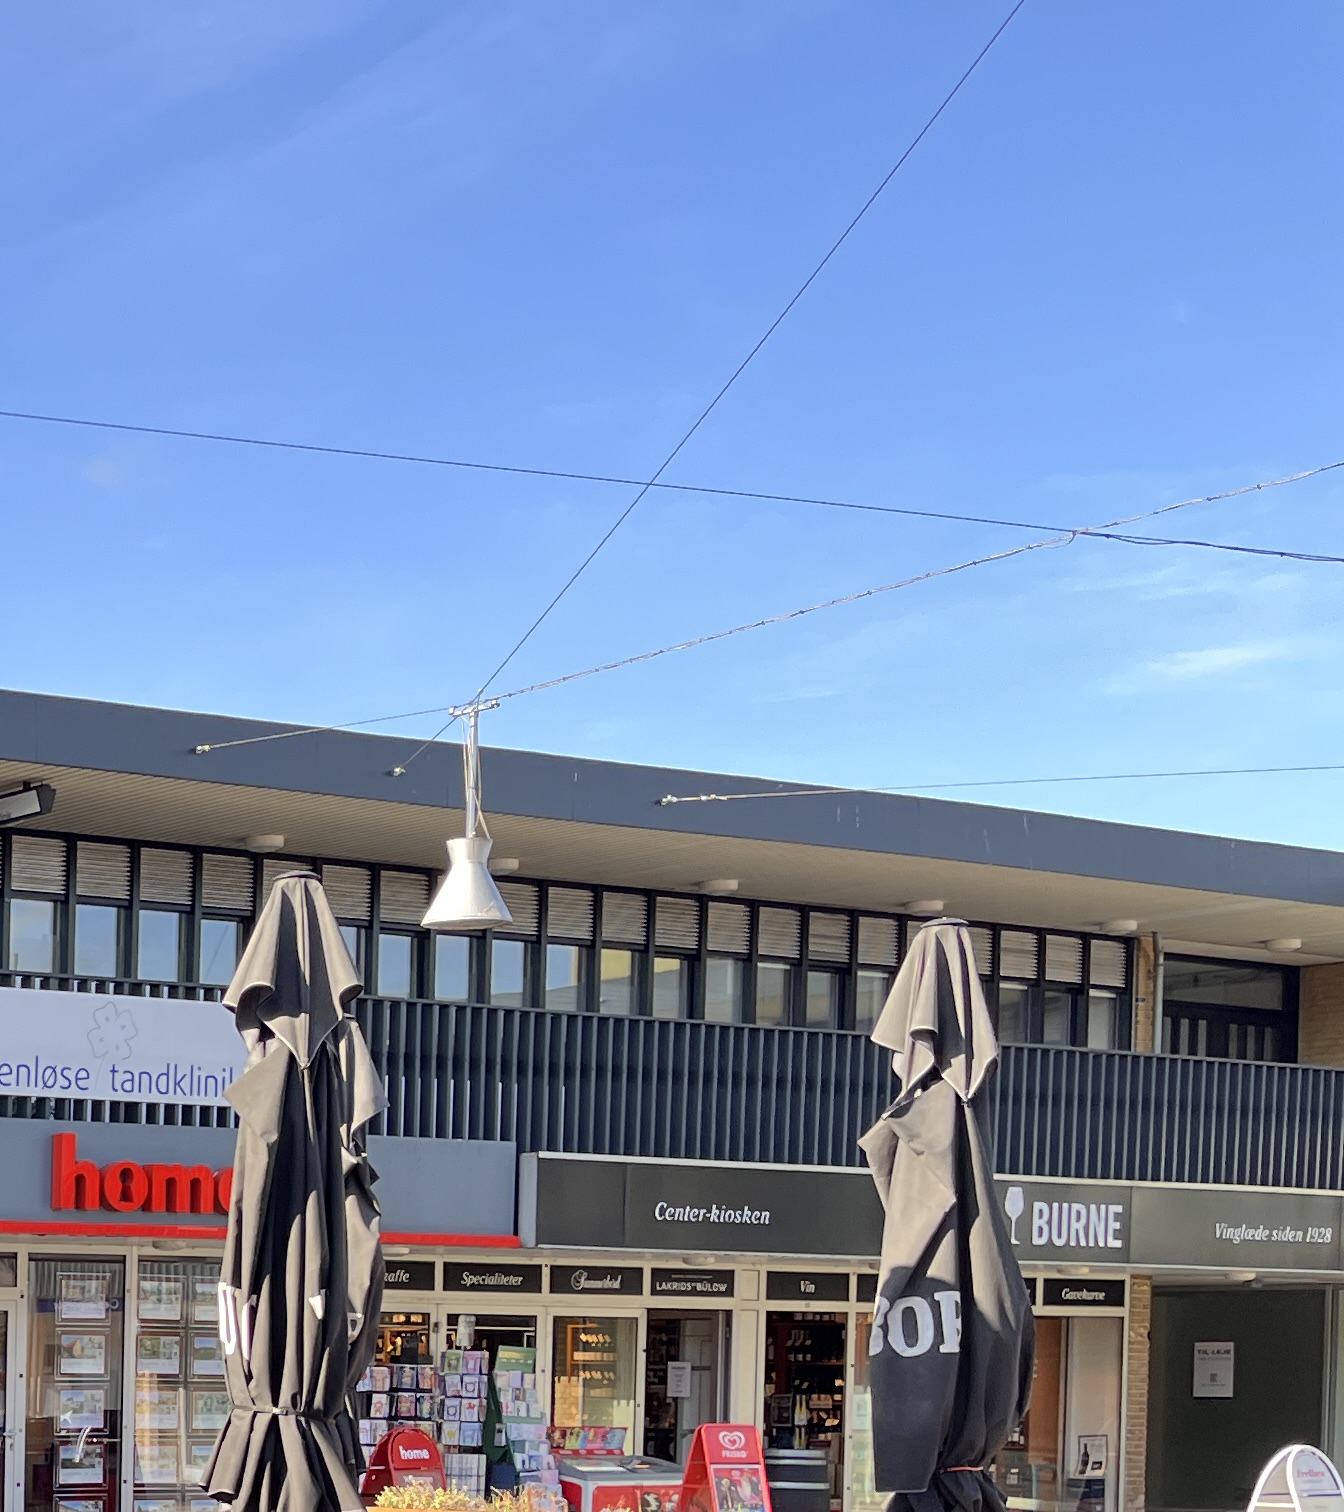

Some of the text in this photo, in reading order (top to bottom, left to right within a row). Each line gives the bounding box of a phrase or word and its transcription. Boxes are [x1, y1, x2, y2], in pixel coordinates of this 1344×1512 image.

[654, 1201, 771, 1225] Center-kiosken
[1032, 1201, 1123, 1249] BURNE
[1215, 1222, 1333, 1245] Vinglæde siden 1928
[656, 1280, 691, 1291] LAKRIDS
[398, 1445, 430, 1460] home
